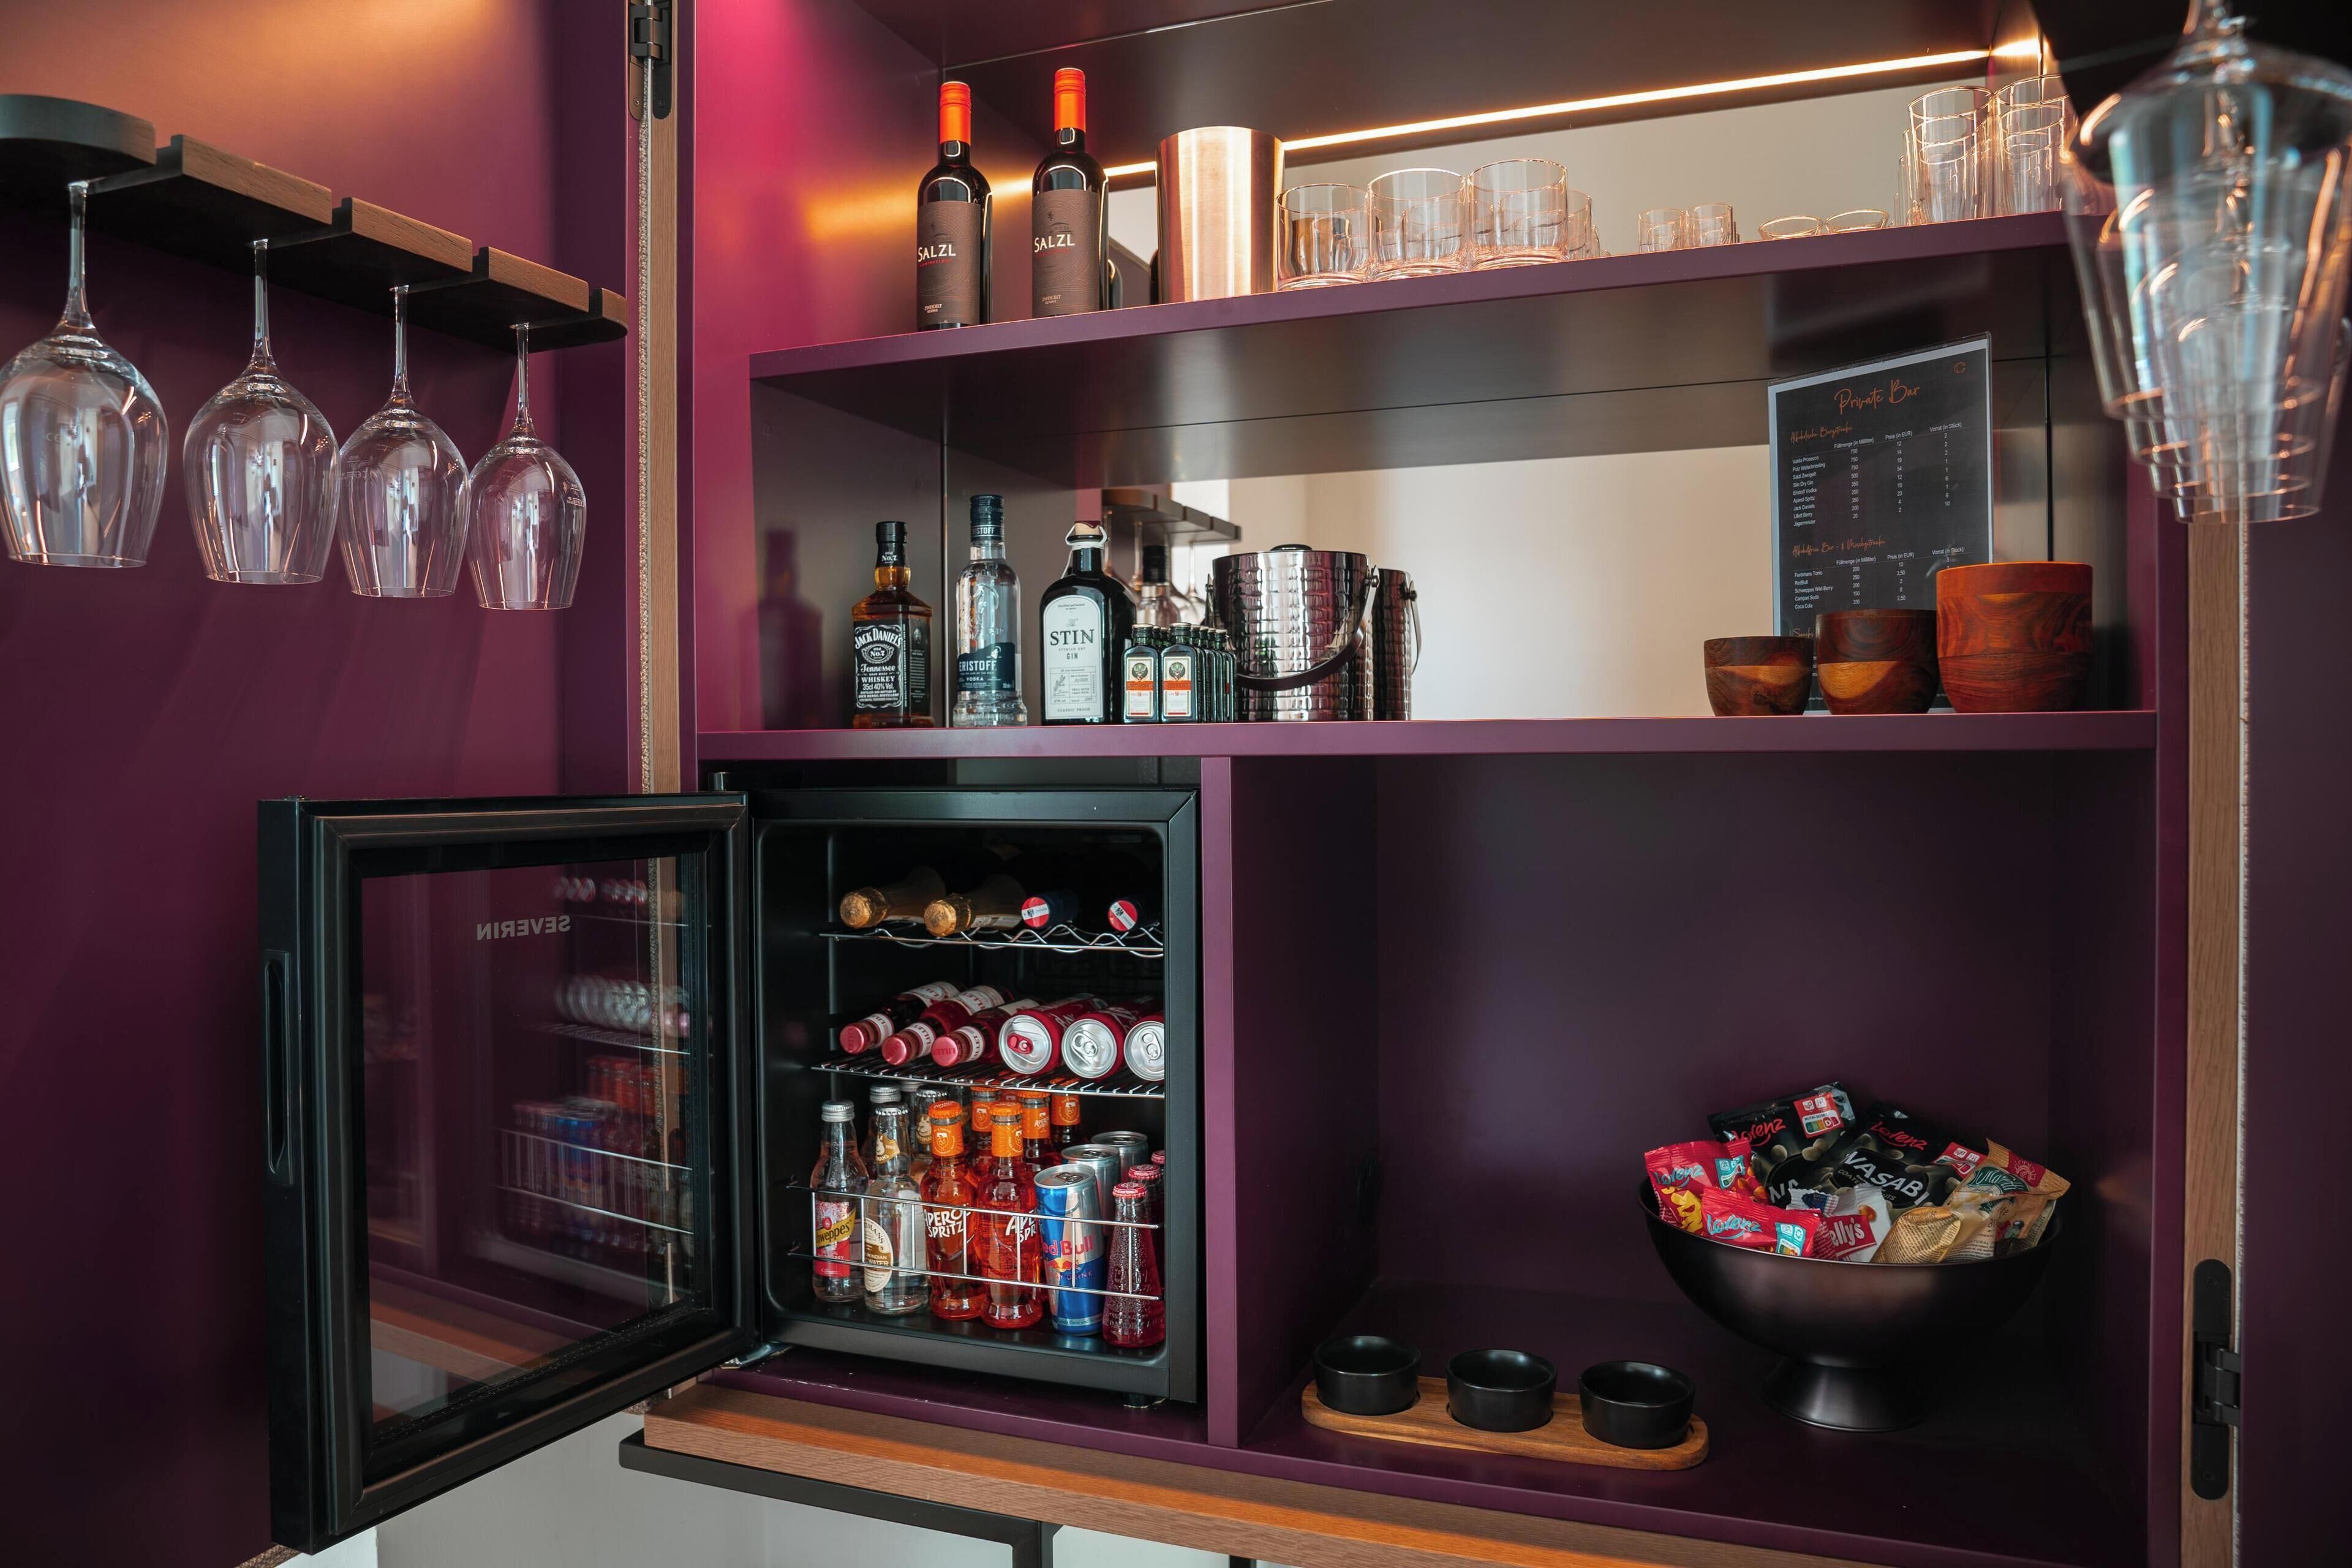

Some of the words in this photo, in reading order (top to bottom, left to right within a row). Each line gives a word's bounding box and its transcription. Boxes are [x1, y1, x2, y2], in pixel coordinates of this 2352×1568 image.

[918, 244, 956, 262] SALZL
[1035, 234, 1075, 252] SALZL
[1834, 388, 1884, 415] Private
[1888, 379, 1920, 404] Bar
[855, 631, 873, 649] JACK
[873, 628, 903, 648] DANIEL'S
[1050, 629, 1095, 646] STIN
[861, 664, 895, 673] Tennessee
[959, 660, 997, 671] ERISTOFF
[1871, 1121, 1928, 1151] Lorenz
[1654, 1165, 1704, 1186] Lorenz
[1019, 1224, 1037, 1243] SPR
[1706, 1215, 1762, 1237] Lorenz
[1829, 1217, 1865, 1246] elly's
[1042, 1239, 1058, 1256] ed
[1060, 1234, 1093, 1256] Bull
[1067, 1272, 1092, 1280] DINK
